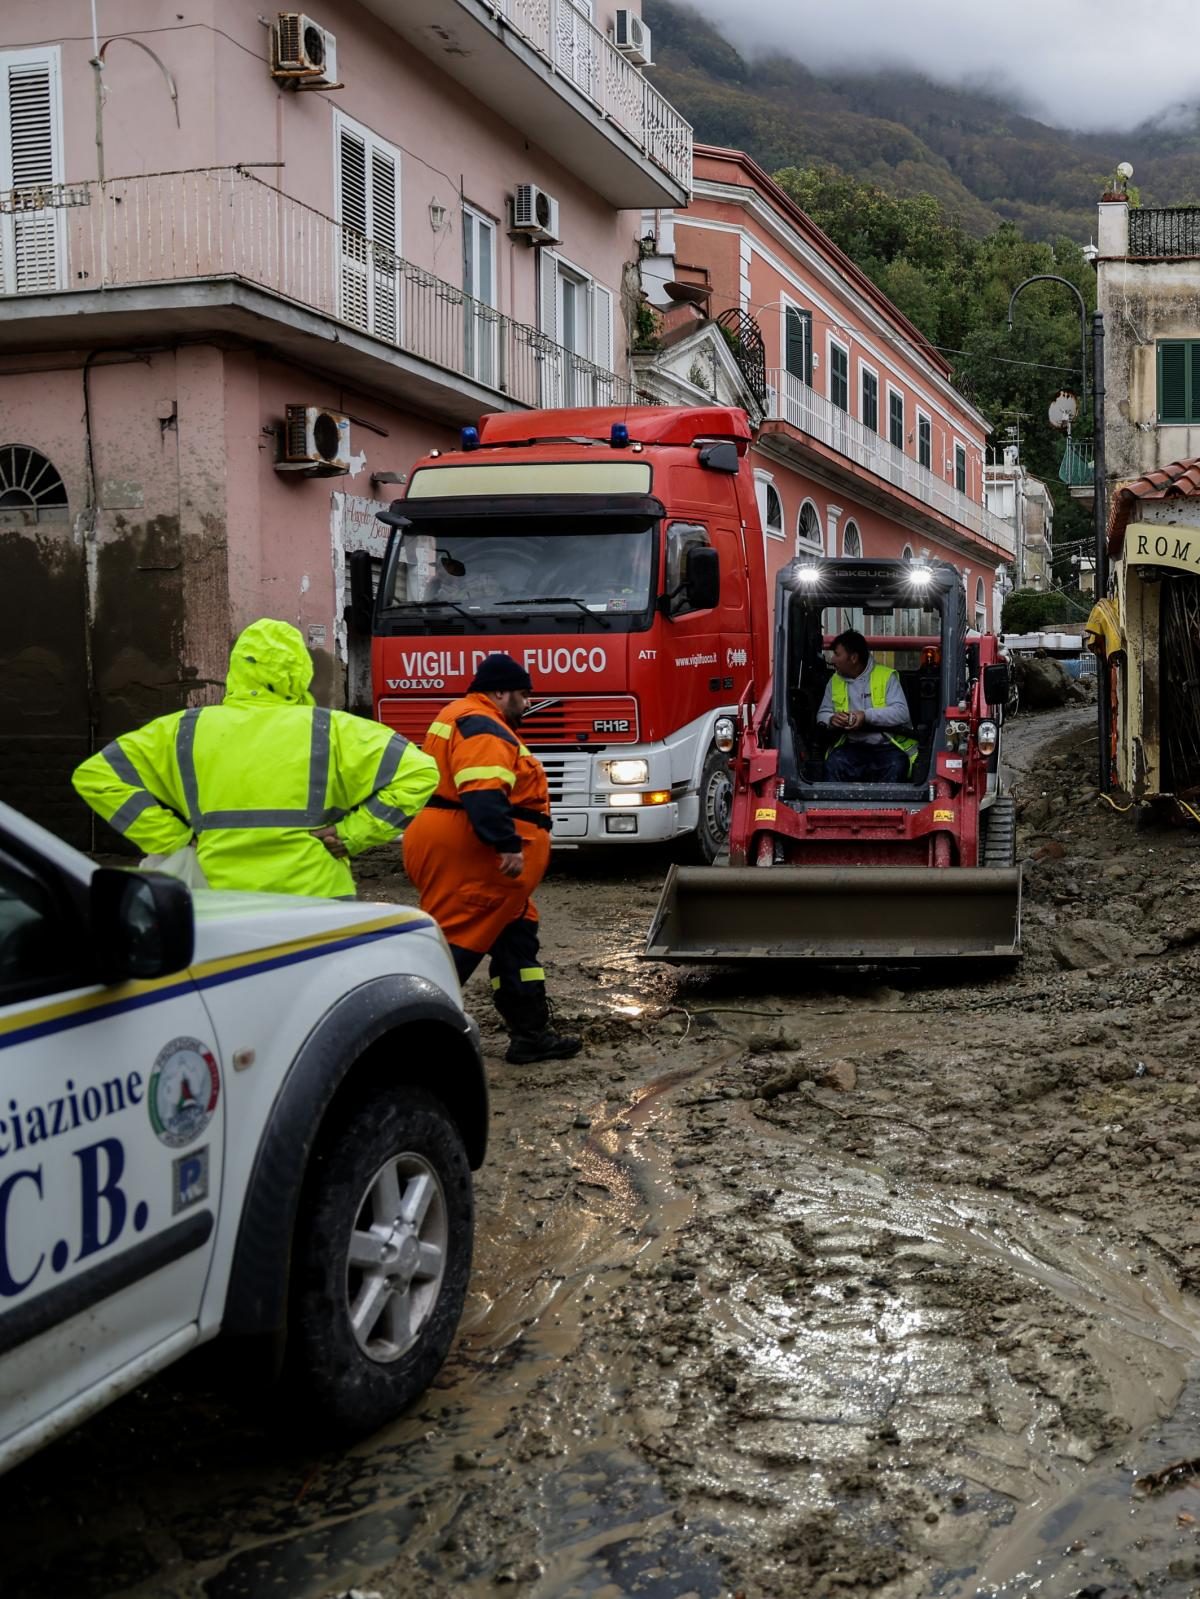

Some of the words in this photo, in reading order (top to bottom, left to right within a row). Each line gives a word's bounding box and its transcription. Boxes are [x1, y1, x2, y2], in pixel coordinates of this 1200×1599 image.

[401, 651, 465, 677] VIGILI
[523, 647, 607, 674] FUOCO
[386, 679, 445, 689] VOLVO
[593, 720, 630, 732] FH12
